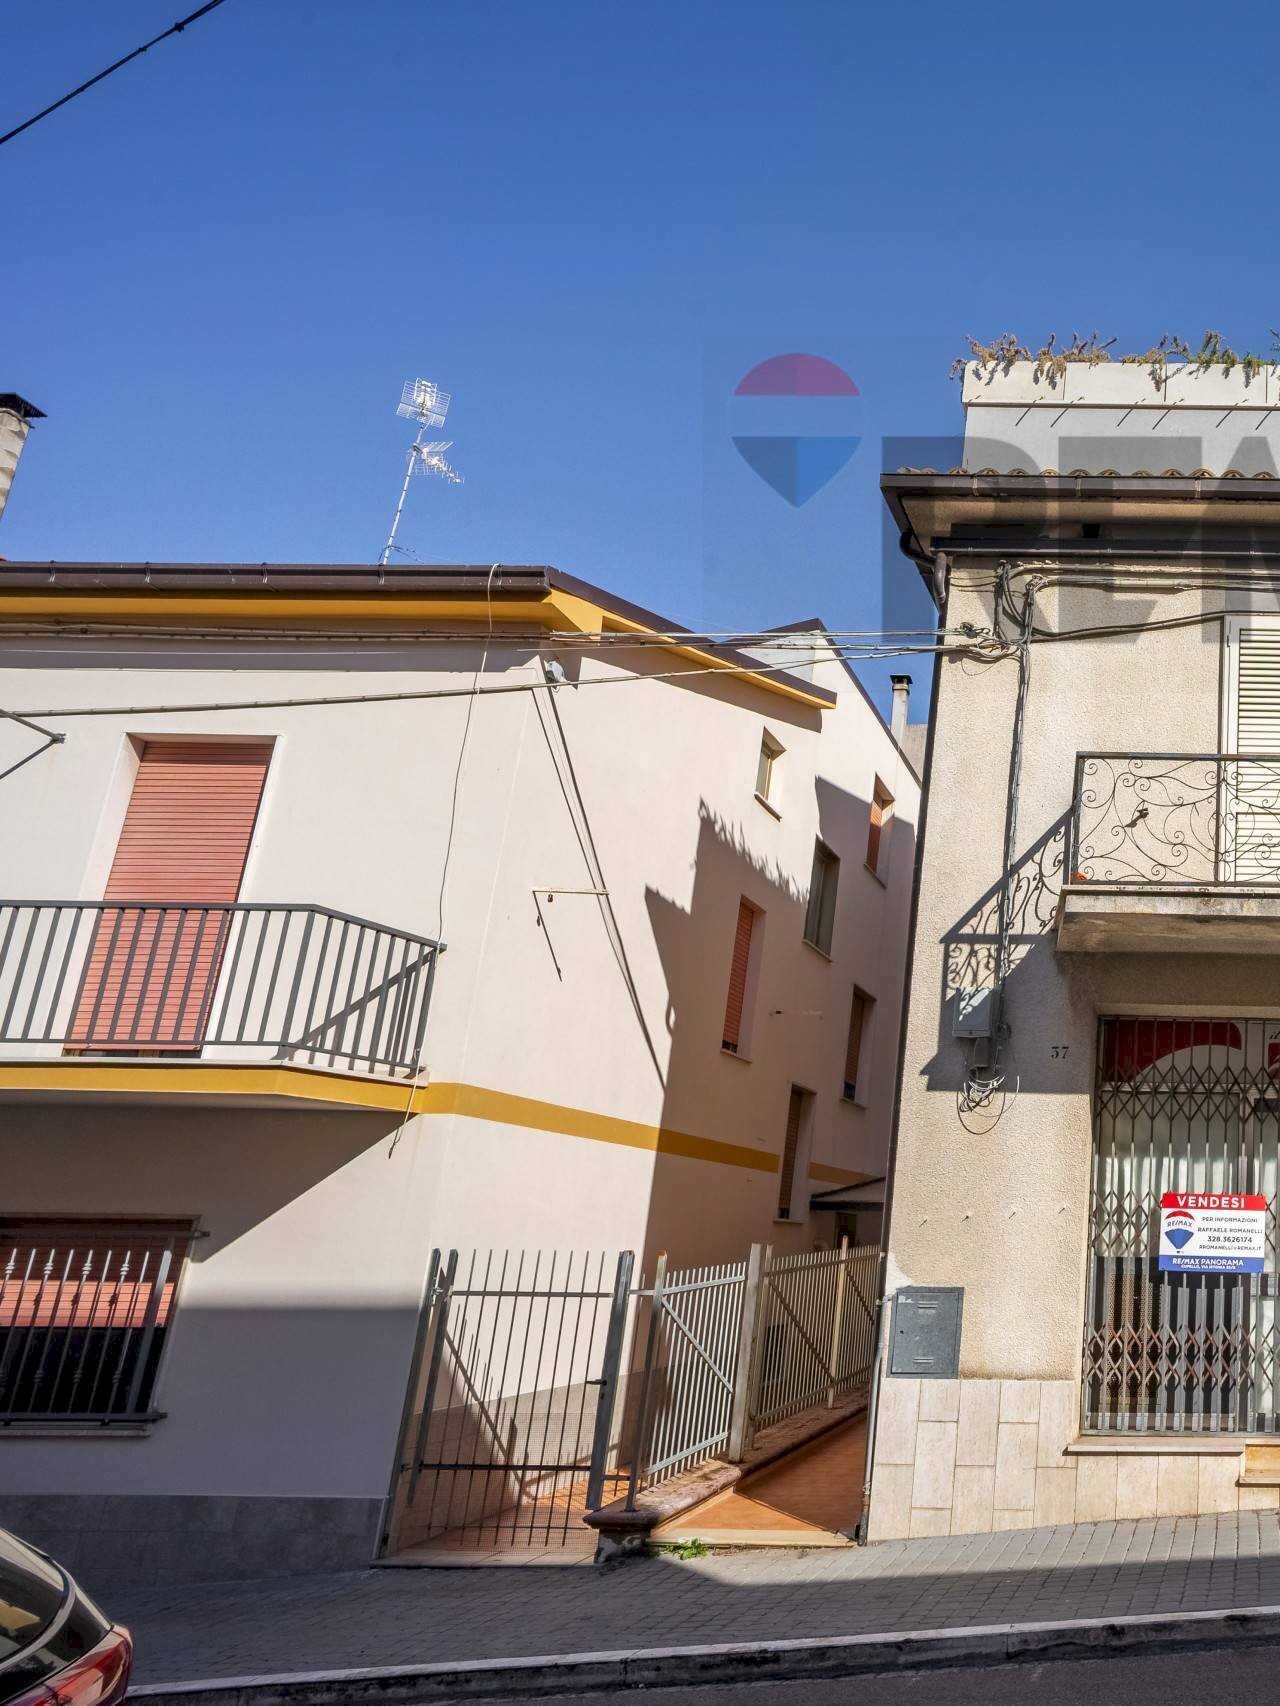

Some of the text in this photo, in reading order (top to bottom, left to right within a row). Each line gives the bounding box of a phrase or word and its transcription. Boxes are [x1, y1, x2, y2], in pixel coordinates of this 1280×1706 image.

[1176, 1196, 1245, 1209] VENDESI
[1167, 1220, 1193, 1228] RE/MAX
[1172, 1257, 1244, 1266] RE/MAX PANORAMA
